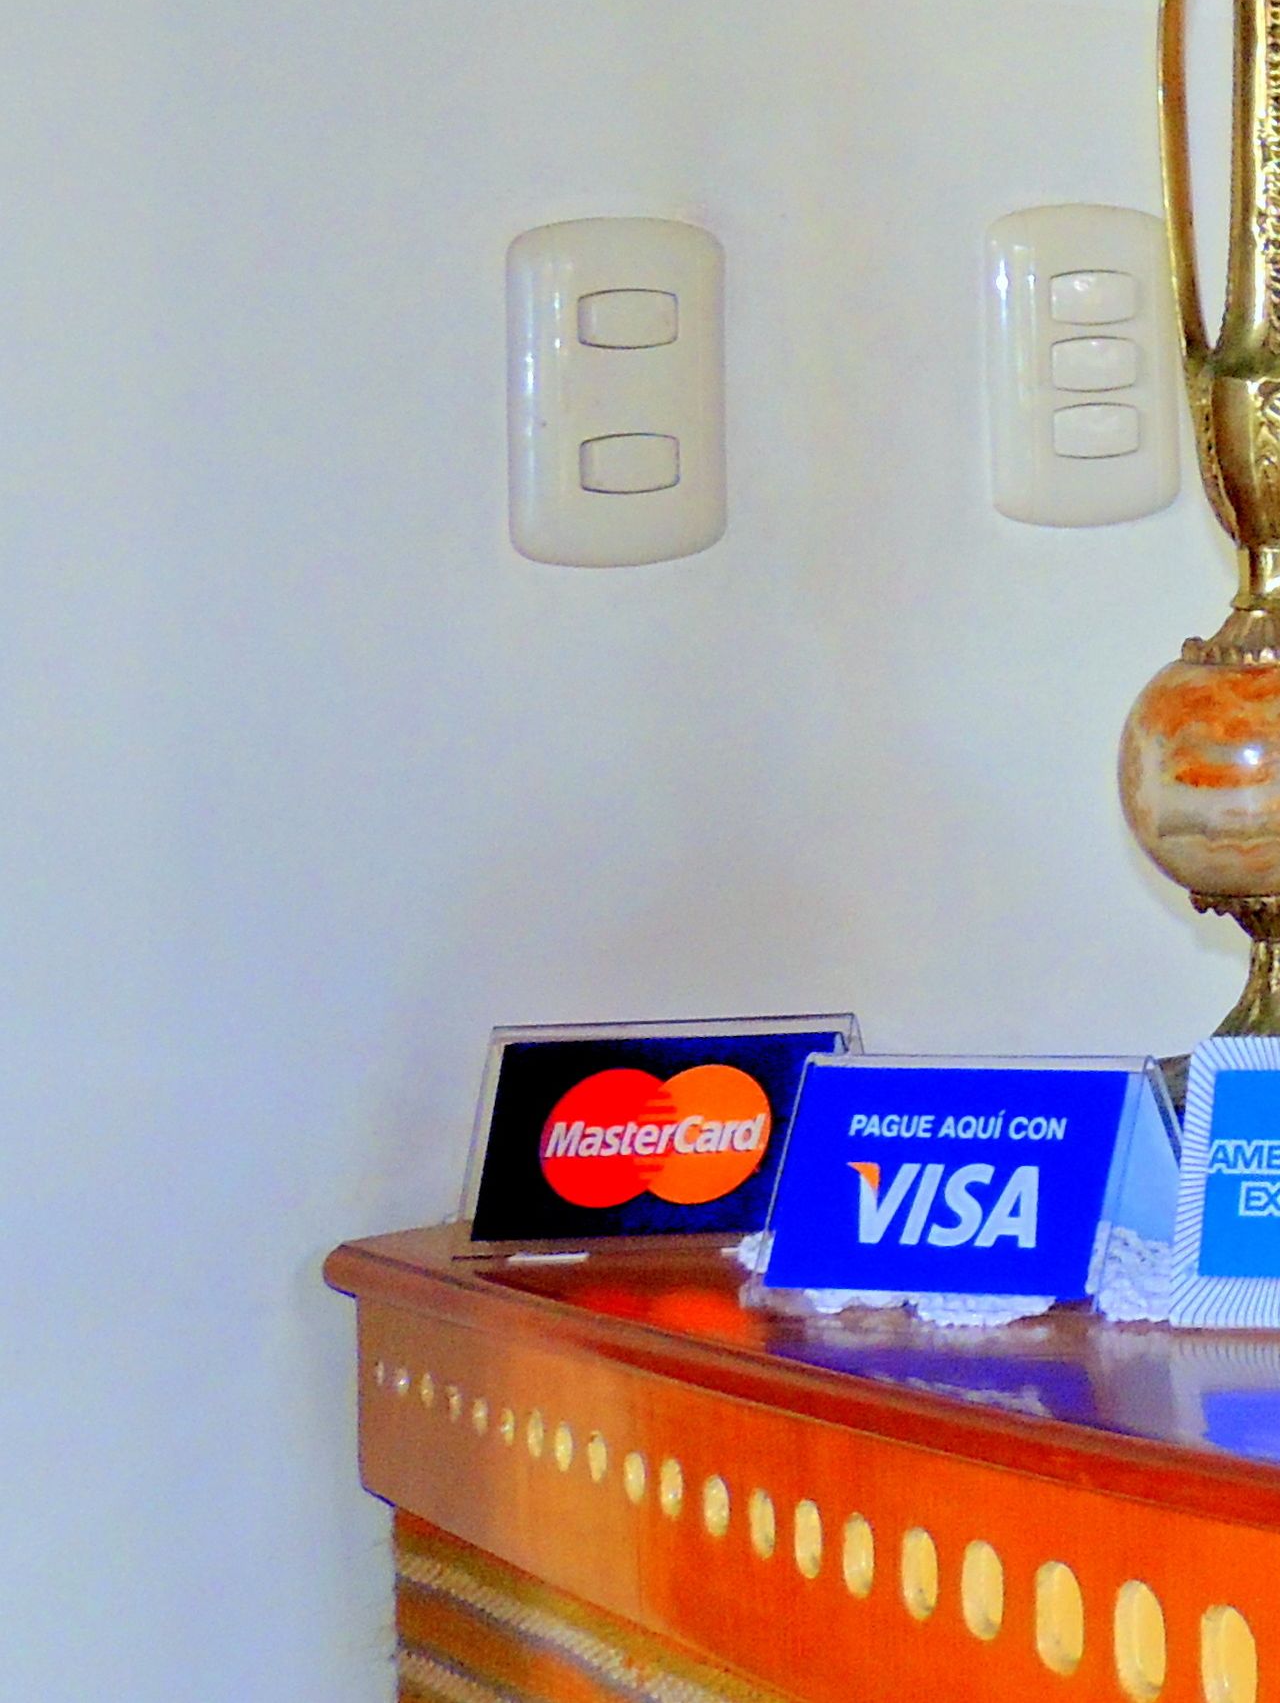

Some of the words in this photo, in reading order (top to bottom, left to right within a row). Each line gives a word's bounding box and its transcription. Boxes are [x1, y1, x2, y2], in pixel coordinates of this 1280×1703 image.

[545, 1113, 767, 1158] MasterCard
[848, 1114, 935, 1138] PAGUE
[937, 1110, 1006, 1139] AQUÍ
[1008, 1116, 1068, 1141] CON
[847, 1161, 1039, 1248] VISA
